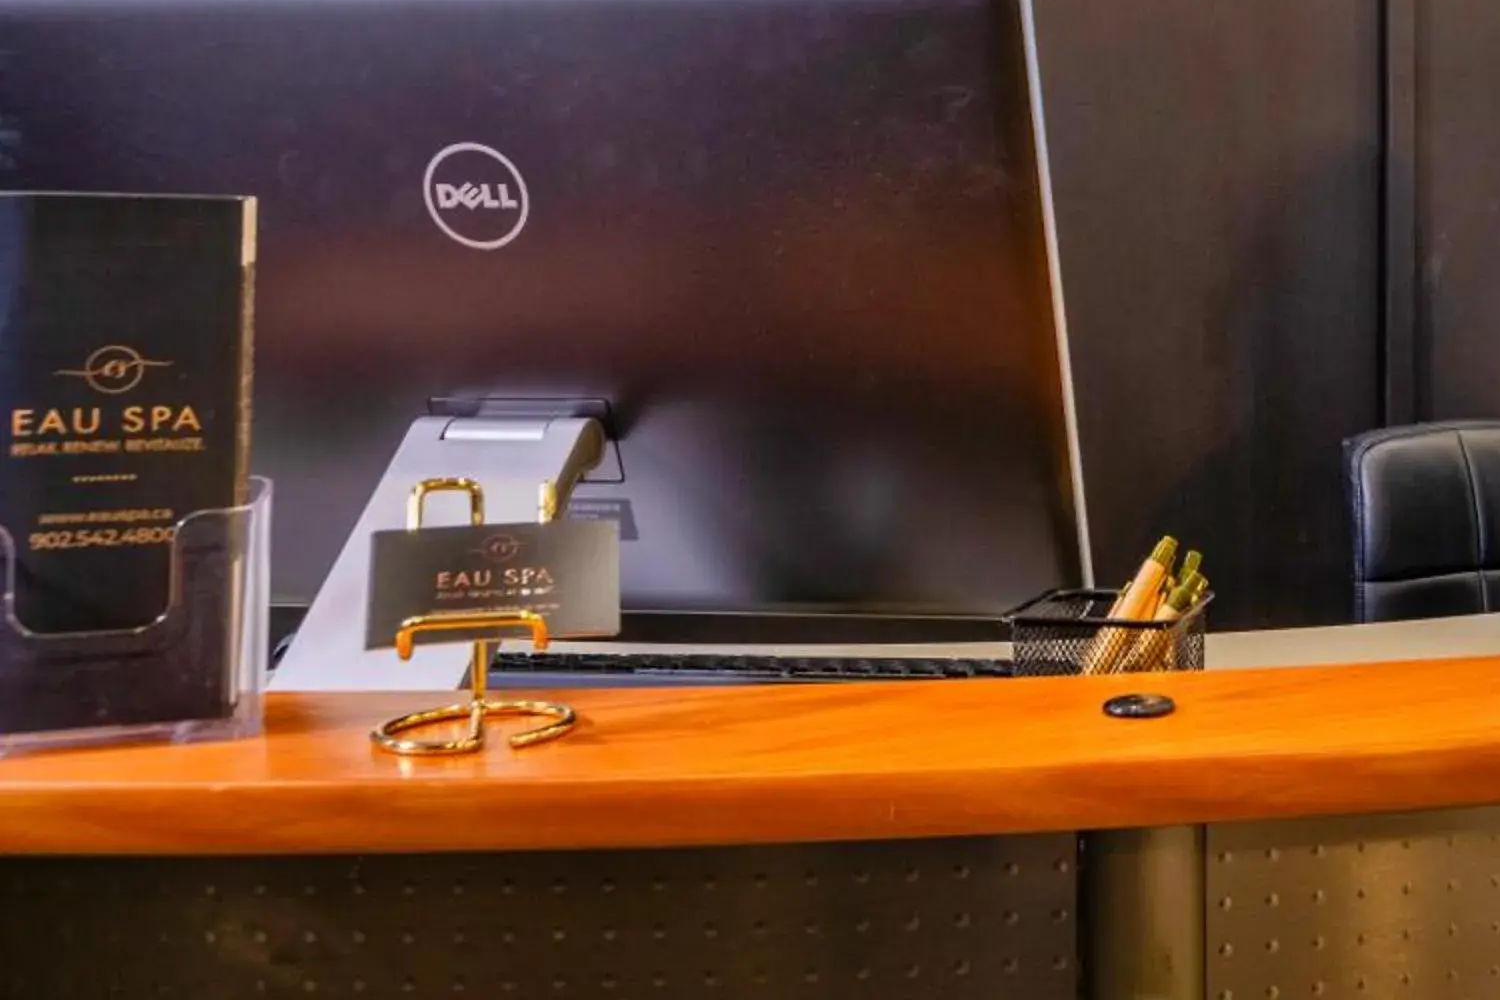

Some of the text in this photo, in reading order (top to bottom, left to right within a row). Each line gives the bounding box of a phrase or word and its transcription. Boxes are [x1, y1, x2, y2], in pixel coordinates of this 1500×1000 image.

[435, 182, 518, 210] DELL
[11, 405, 201, 436] EAU SPA
[436, 567, 554, 589] EAU SPA
